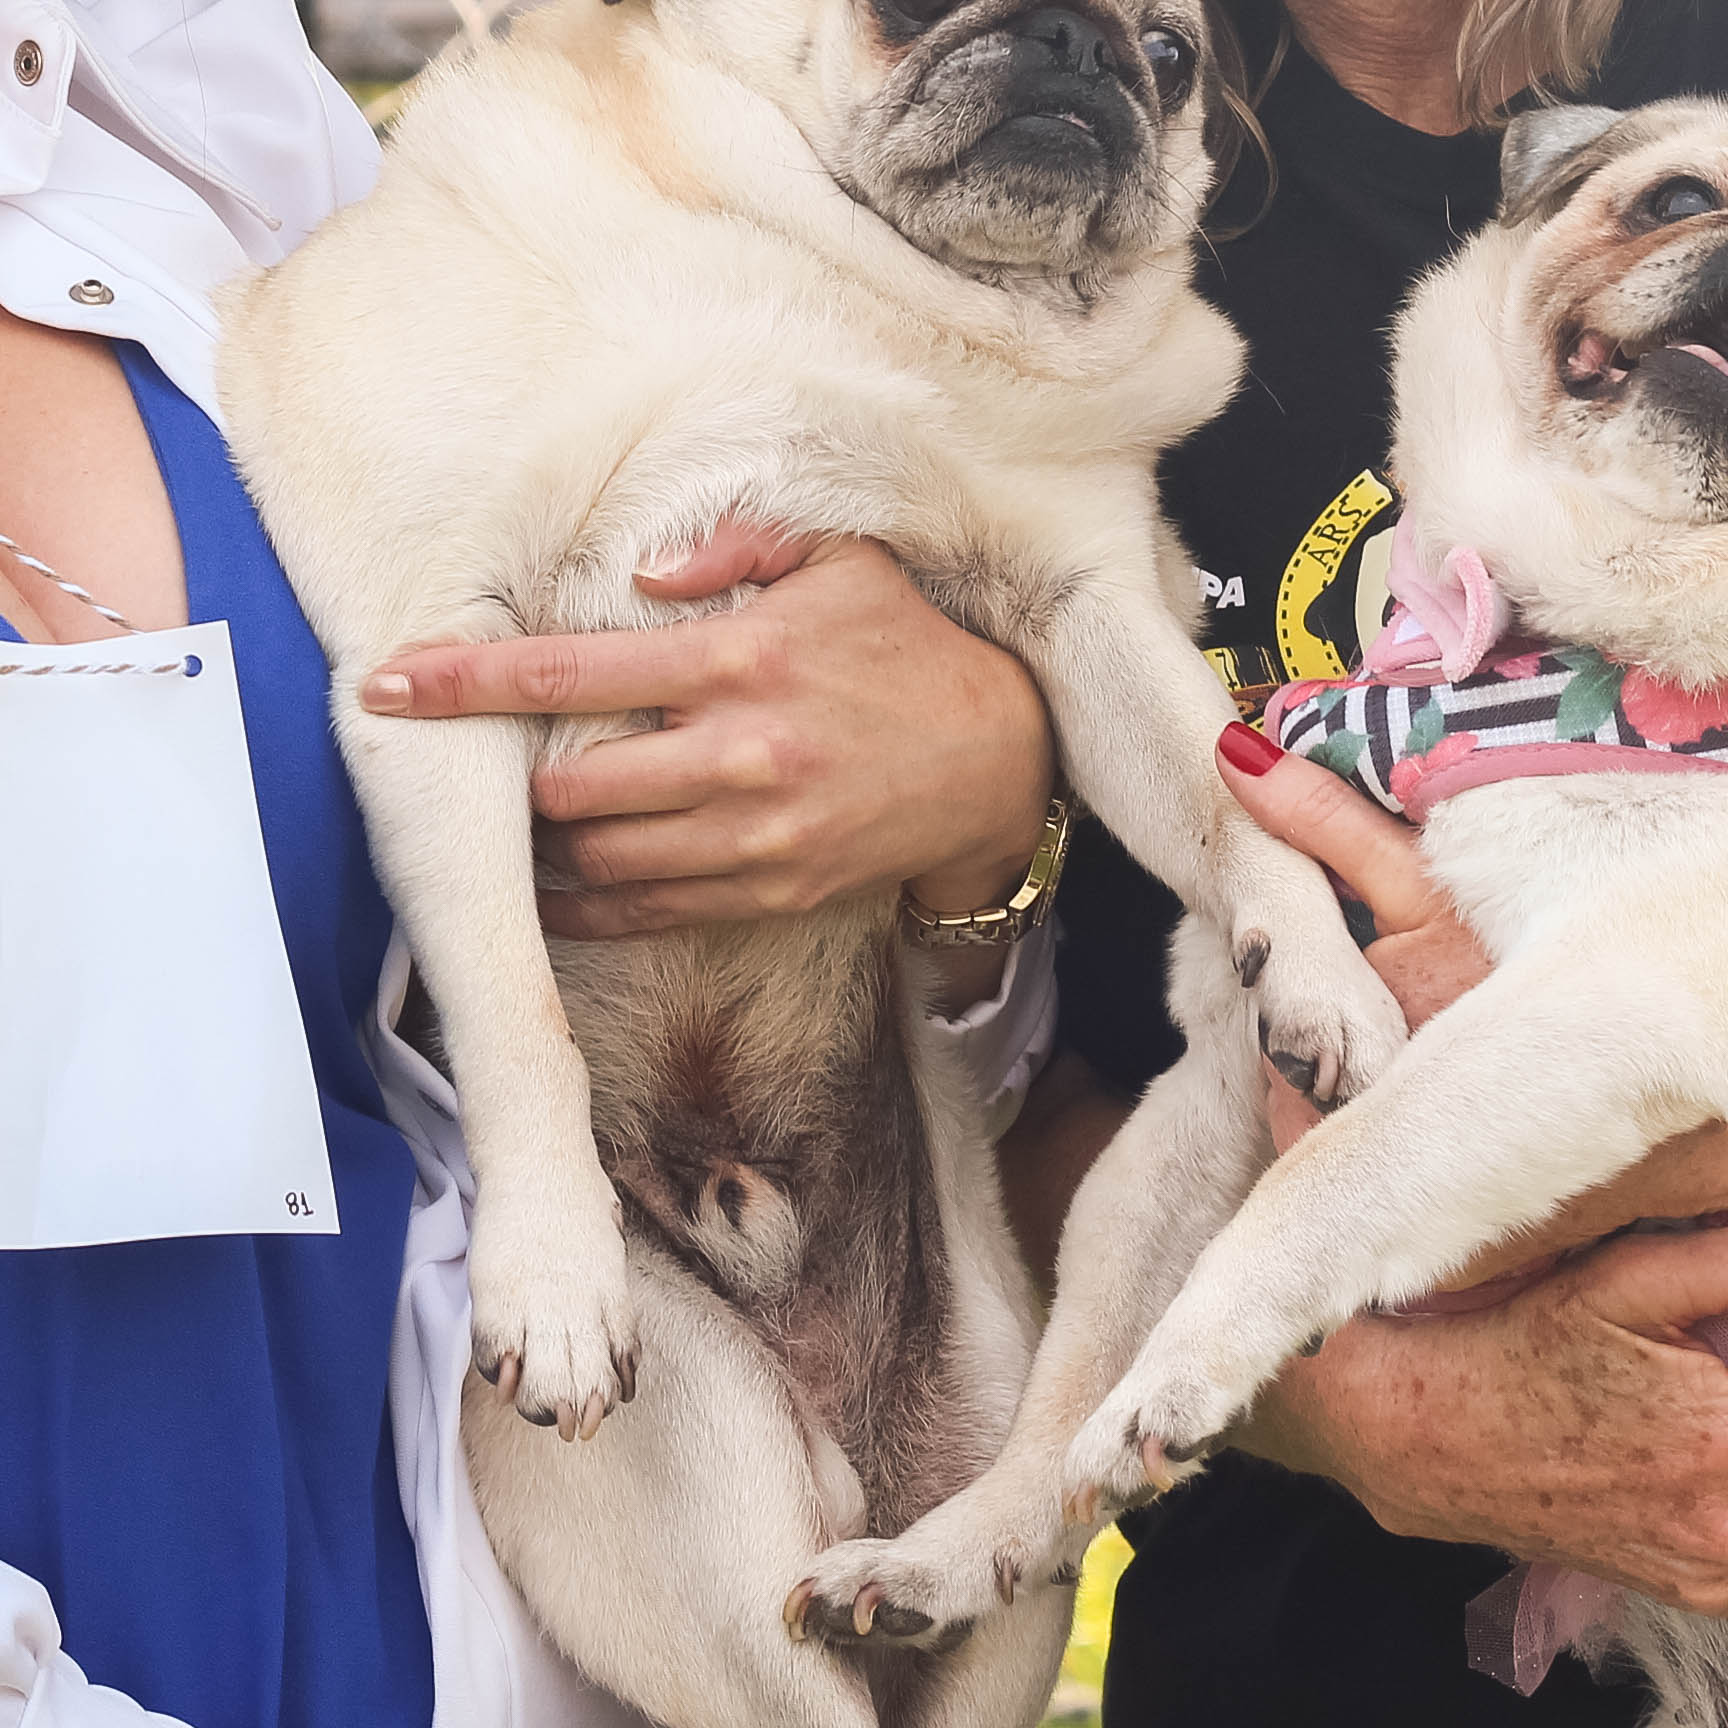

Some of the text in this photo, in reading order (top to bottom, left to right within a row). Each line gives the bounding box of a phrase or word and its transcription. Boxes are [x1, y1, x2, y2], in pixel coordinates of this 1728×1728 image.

[1308, 495, 1363, 567] ARS
[1192, 565, 1246, 609] PA
[285, 1191, 314, 1216] 81
